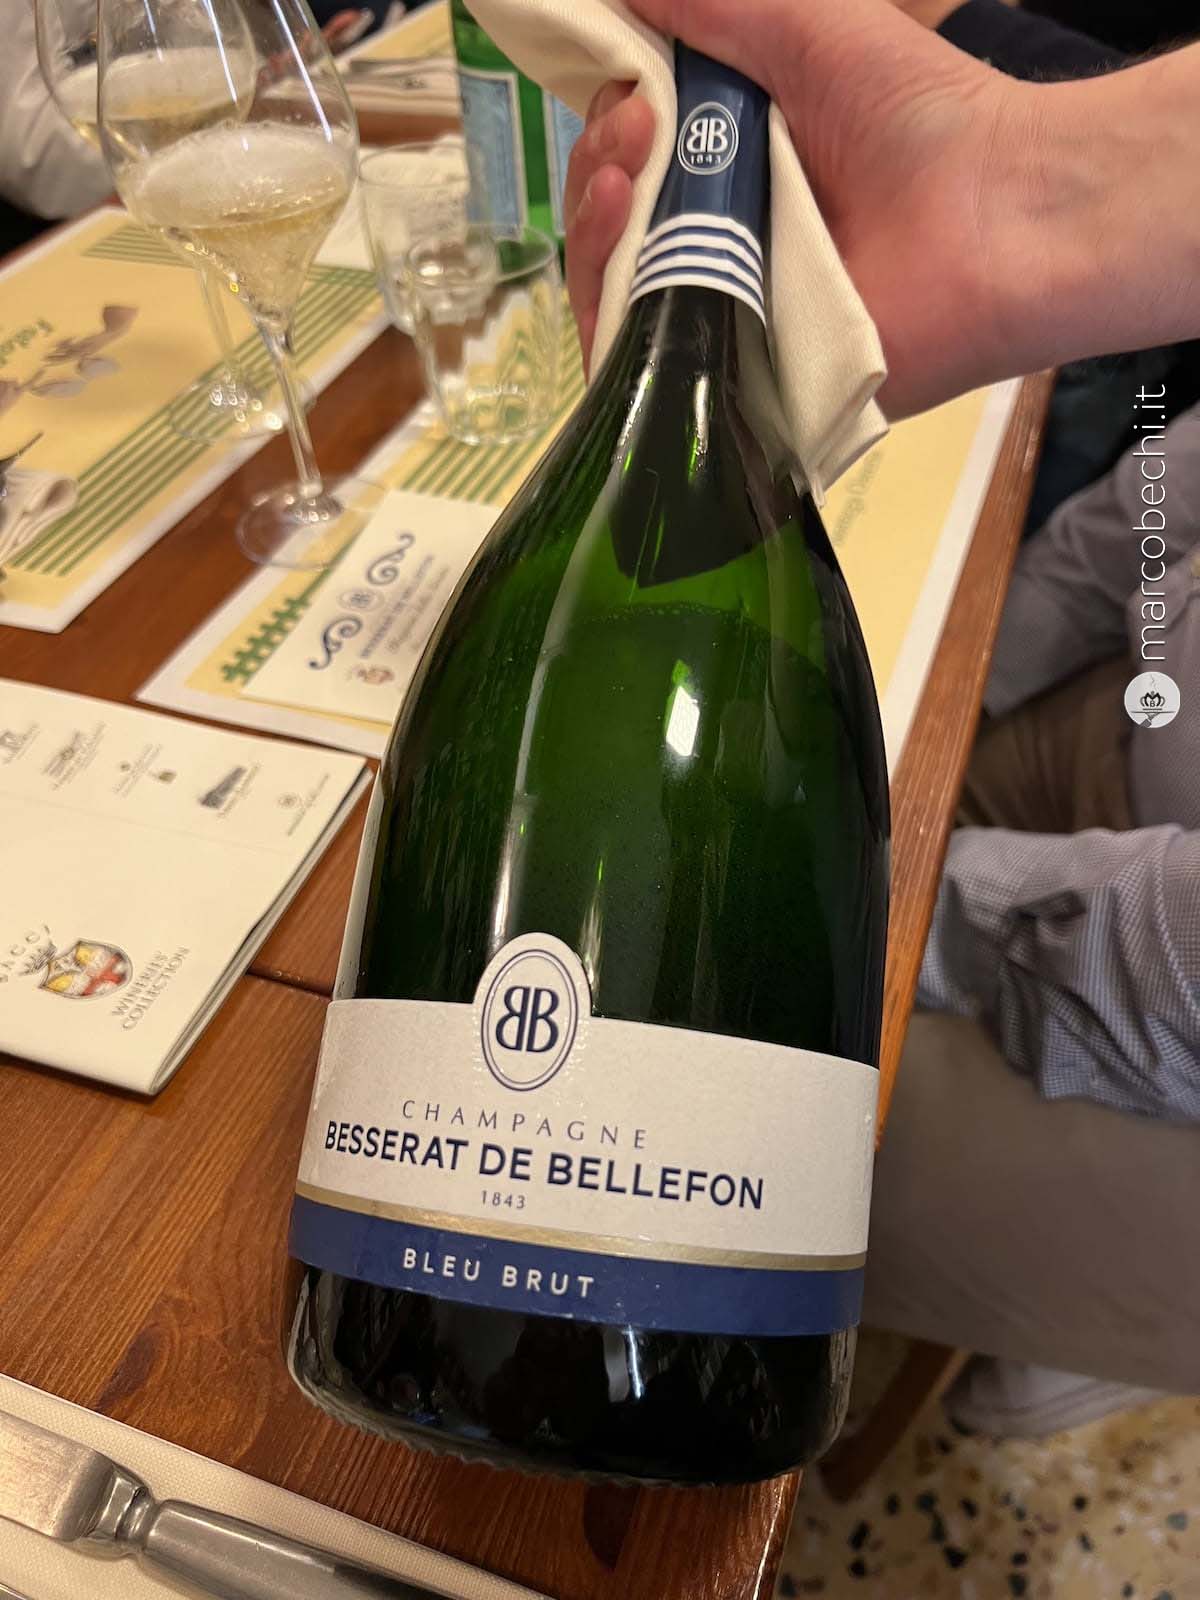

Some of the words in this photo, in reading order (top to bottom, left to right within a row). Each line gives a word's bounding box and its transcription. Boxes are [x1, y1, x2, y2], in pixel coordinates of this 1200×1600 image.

[402, 1099, 648, 1149] CHAMPAGNE
[324, 1120, 469, 1170] BESSERAT
[479, 1143, 533, 1181] DE
[547, 1152, 764, 1210] BELLEFON
[480, 1189, 527, 1210] 1843
[402, 1247, 481, 1281] BLEU
[501, 1263, 595, 1299] BRUT
